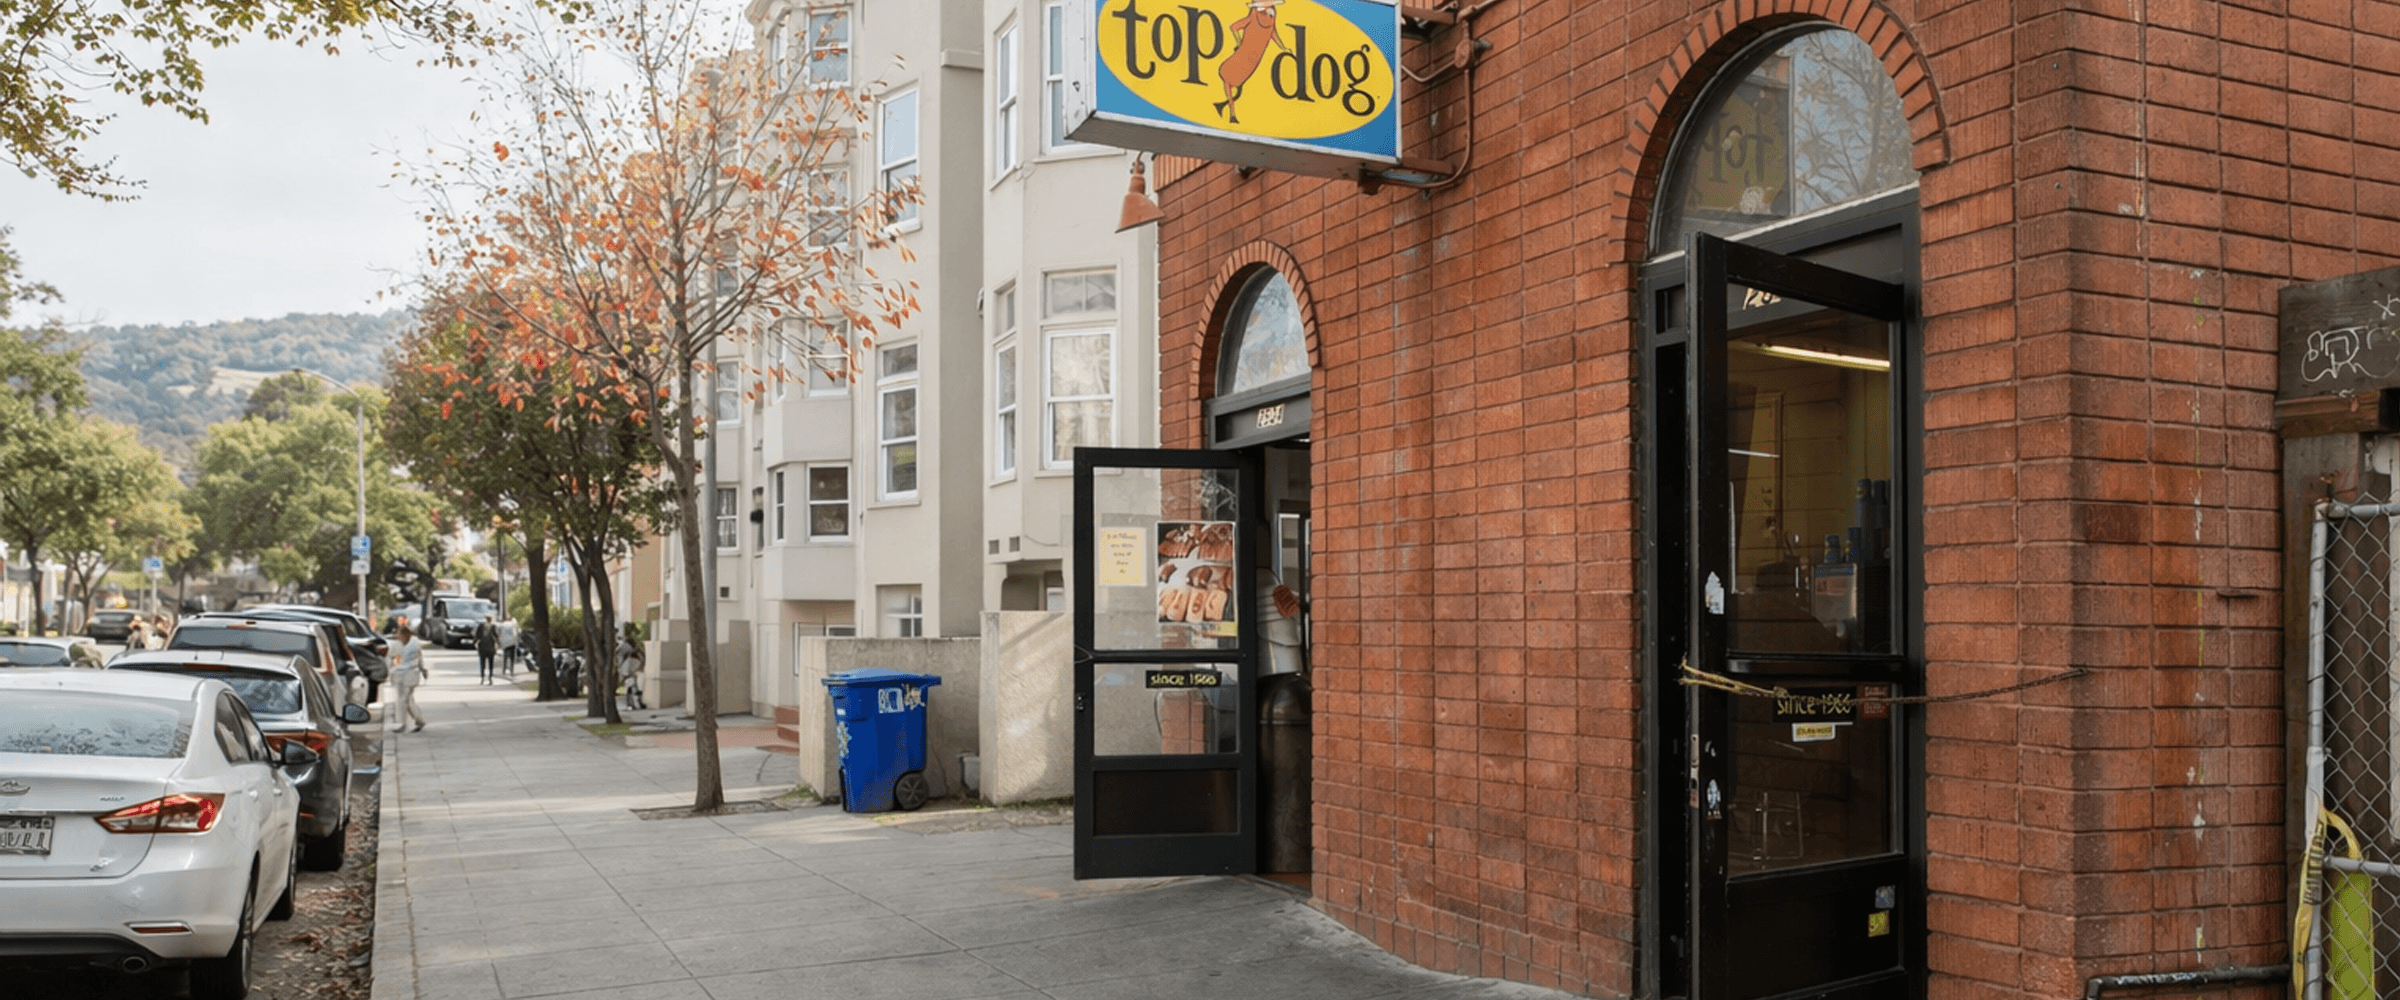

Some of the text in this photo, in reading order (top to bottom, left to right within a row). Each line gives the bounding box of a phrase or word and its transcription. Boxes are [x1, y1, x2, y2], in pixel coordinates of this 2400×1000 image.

[1111, 0, 1376, 117] top dog
[1150, 673, 1185, 685] since
[1777, 695, 1816, 715] since
